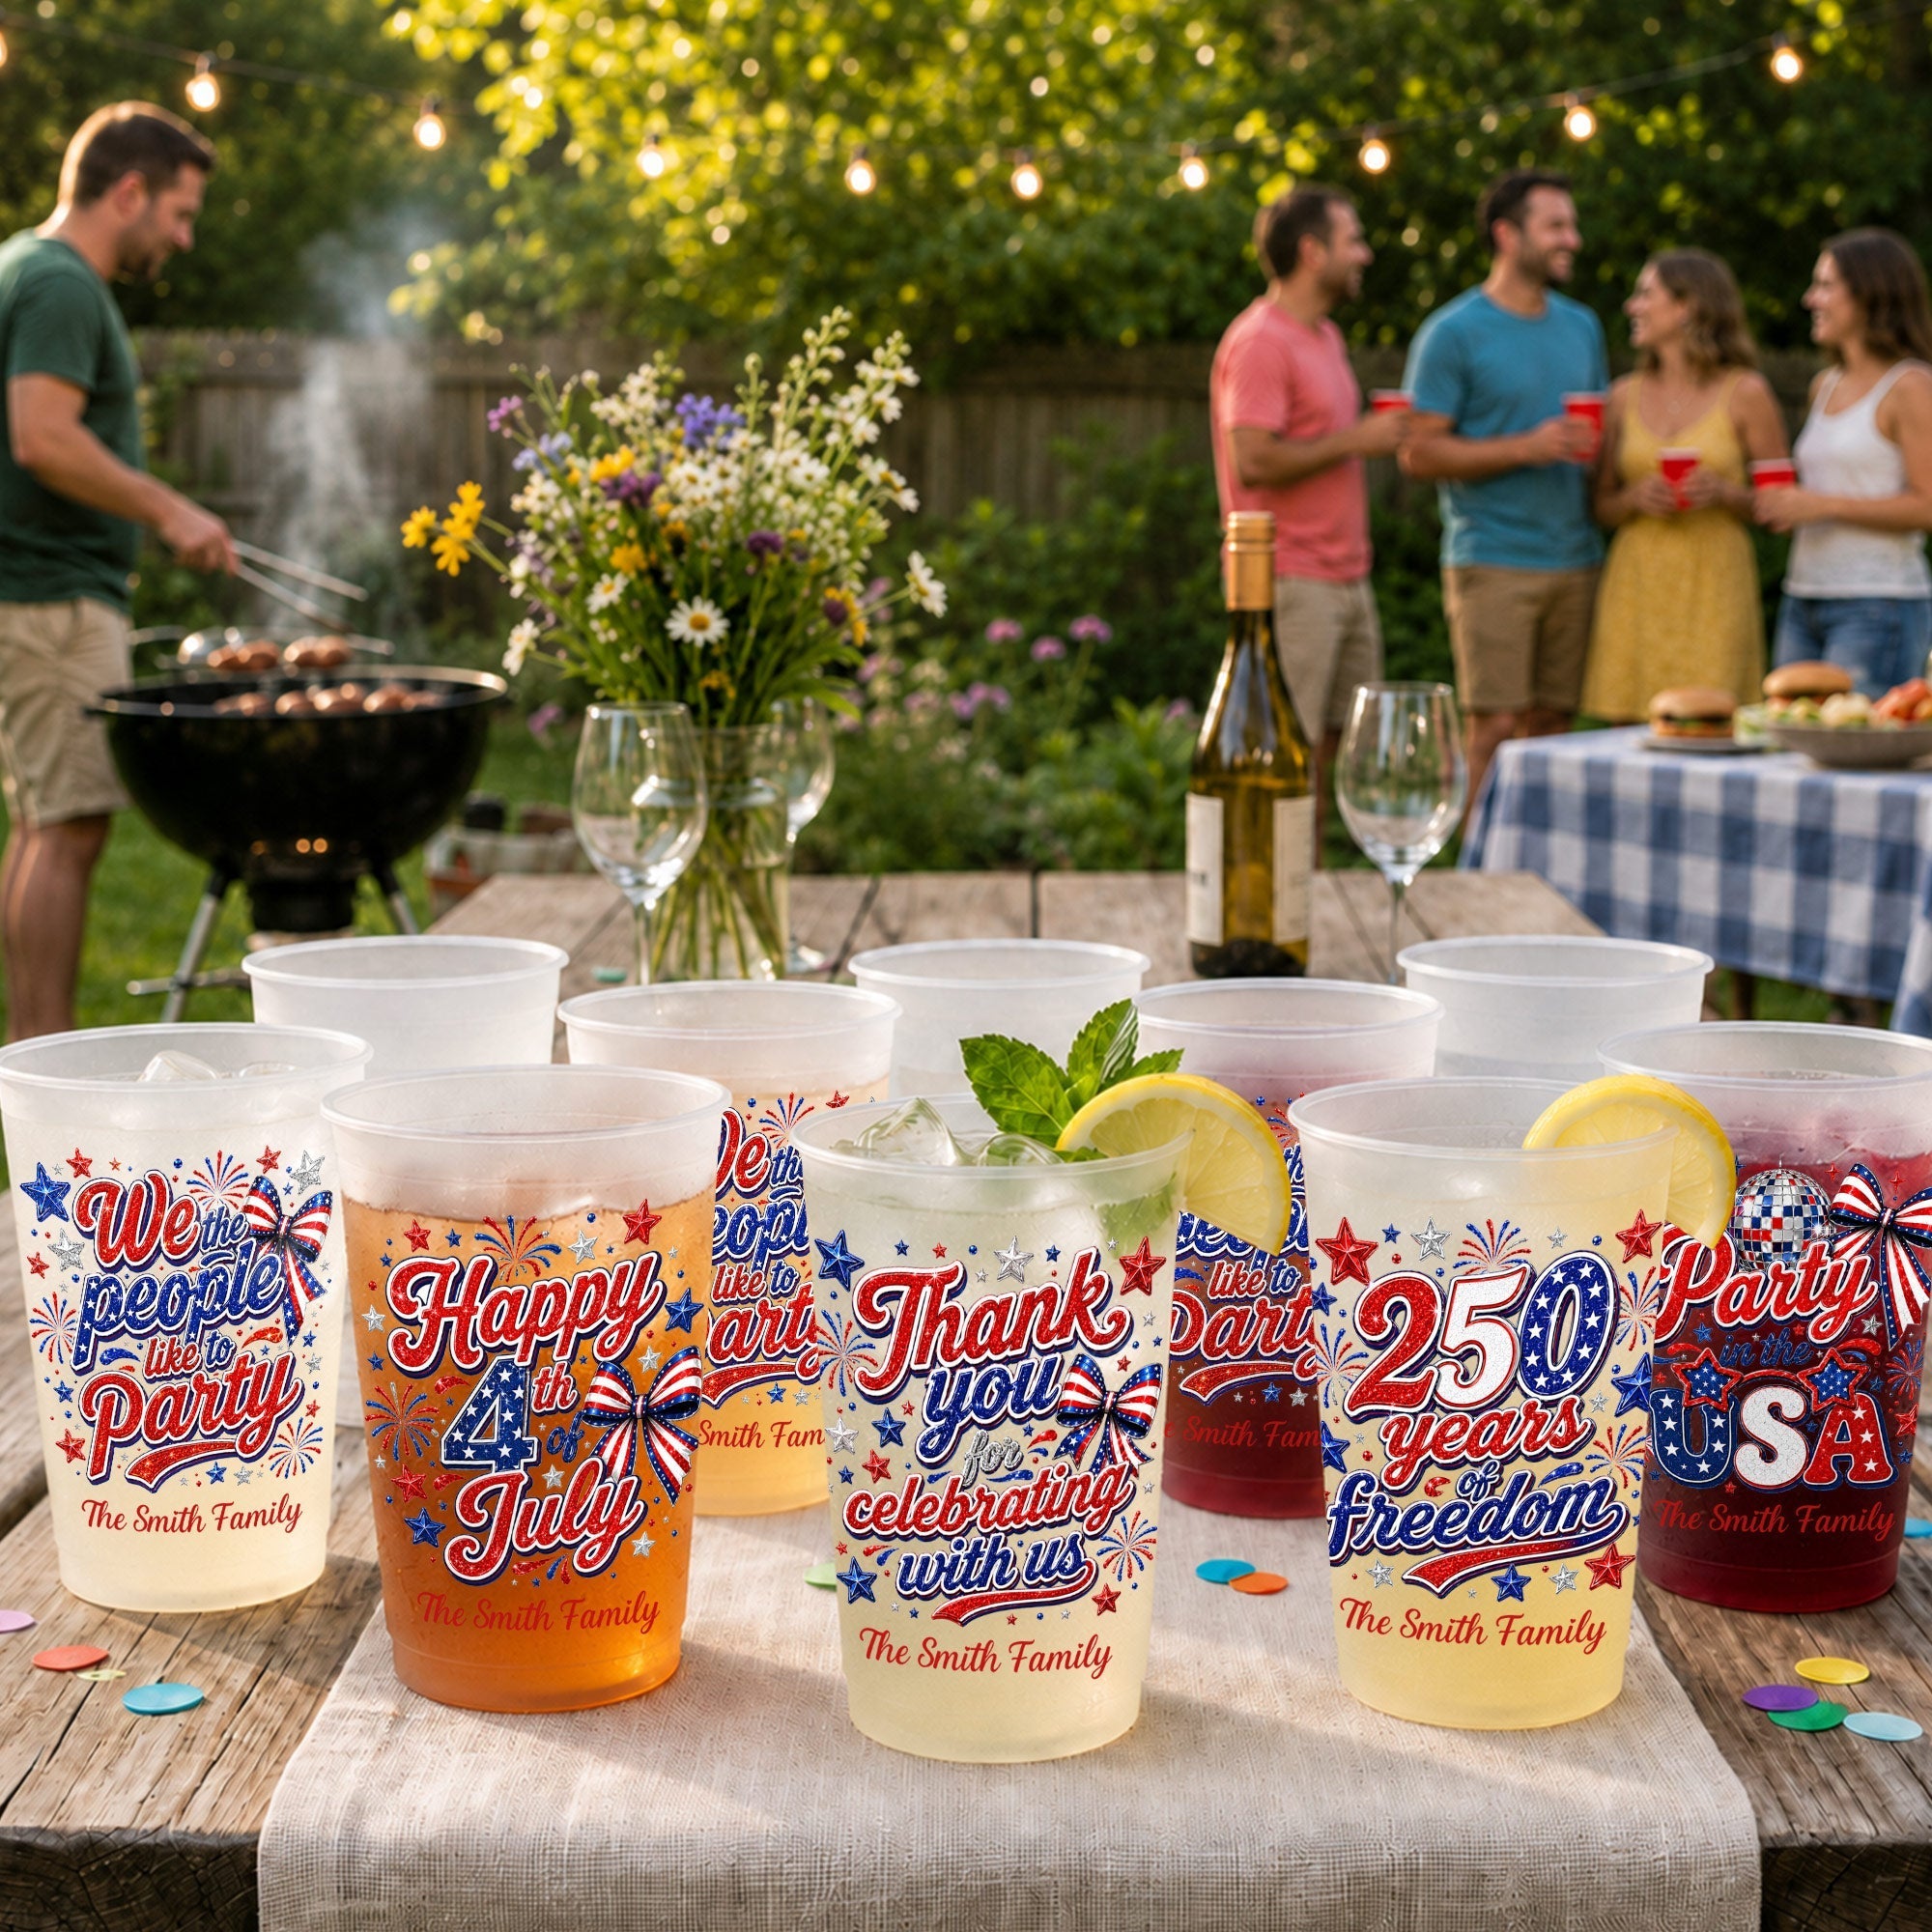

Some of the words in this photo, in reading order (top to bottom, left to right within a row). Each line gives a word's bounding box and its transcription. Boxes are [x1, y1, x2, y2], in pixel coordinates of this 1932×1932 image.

[771, 1146, 804, 1188] th
[71, 1169, 202, 1272] We
[199, 1200, 250, 1252] the
[71, 1239, 286, 1373] people
[711, 1262, 767, 1308] like
[770, 1260, 801, 1298] to
[1208, 1260, 1266, 1303] like
[1269, 1259, 1303, 1296] to
[1654, 1223, 1882, 1349] Party
[385, 1251, 667, 1377] Happy
[852, 1245, 1133, 1399] Thank
[1344, 1249, 1622, 1418] 250
[143, 1333, 200, 1381] like
[205, 1329, 236, 1368] to
[1719, 1334, 1753, 1366] in
[1762, 1327, 1816, 1368] the
[78, 1352, 304, 1485] Party
[546, 1410, 584, 1463] of
[697, 1419, 765, 1450] Smith
[770, 1420, 826, 1450] Fam
[915, 1352, 1065, 1468] you
[1182, 1415, 1258, 1447] Smith
[1264, 1420, 1321, 1448] Fam
[1649, 1384, 1899, 1492] USA
[963, 1430, 1023, 1487] for
[1379, 1394, 1596, 1492] years
[842, 1462, 1135, 1540] celebrating
[1456, 1460, 1500, 1499] of
[81, 1499, 127, 1531] The
[133, 1503, 207, 1534] Smith
[211, 1492, 303, 1534] Family
[442, 1456, 650, 1585] July
[1328, 1467, 1631, 1567] freedom
[1653, 1498, 1701, 1530] The
[1709, 1503, 1788, 1534] Smith
[1795, 1499, 1895, 1542] Family
[896, 1533, 1016, 1599] with
[1021, 1531, 1093, 1594] us
[416, 1591, 468, 1627] The
[471, 1598, 554, 1633] Smith
[556, 1590, 661, 1634] Family
[1340, 1597, 1392, 1634] The
[1401, 1607, 1488, 1645] Smith
[1495, 1608, 1607, 1656] Family
[859, 1627, 911, 1665] The
[918, 1635, 1001, 1673] Smith
[1009, 1634, 1114, 1680] Family
